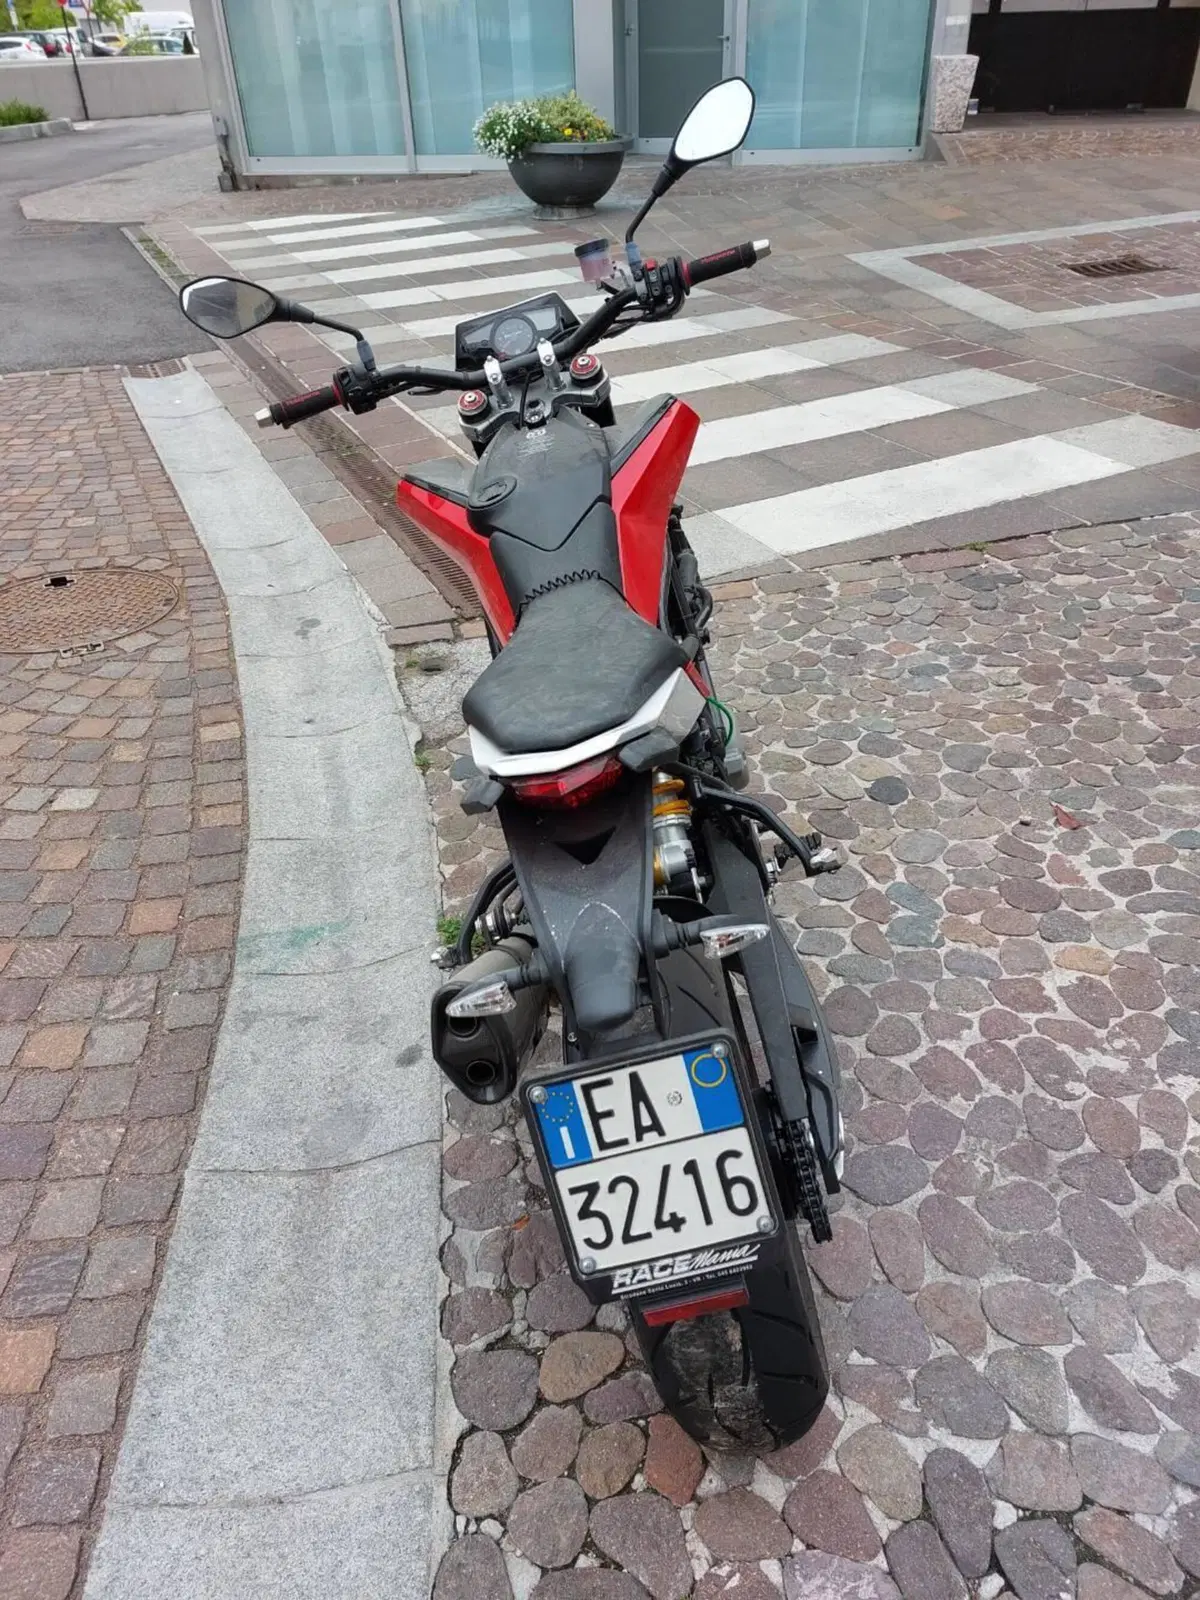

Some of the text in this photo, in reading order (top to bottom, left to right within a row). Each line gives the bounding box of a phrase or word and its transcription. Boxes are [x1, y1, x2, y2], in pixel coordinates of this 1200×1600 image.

[580, 1070, 667, 1152] EA
[567, 1149, 759, 1250] 32416
[612, 1253, 693, 1289] RACE
